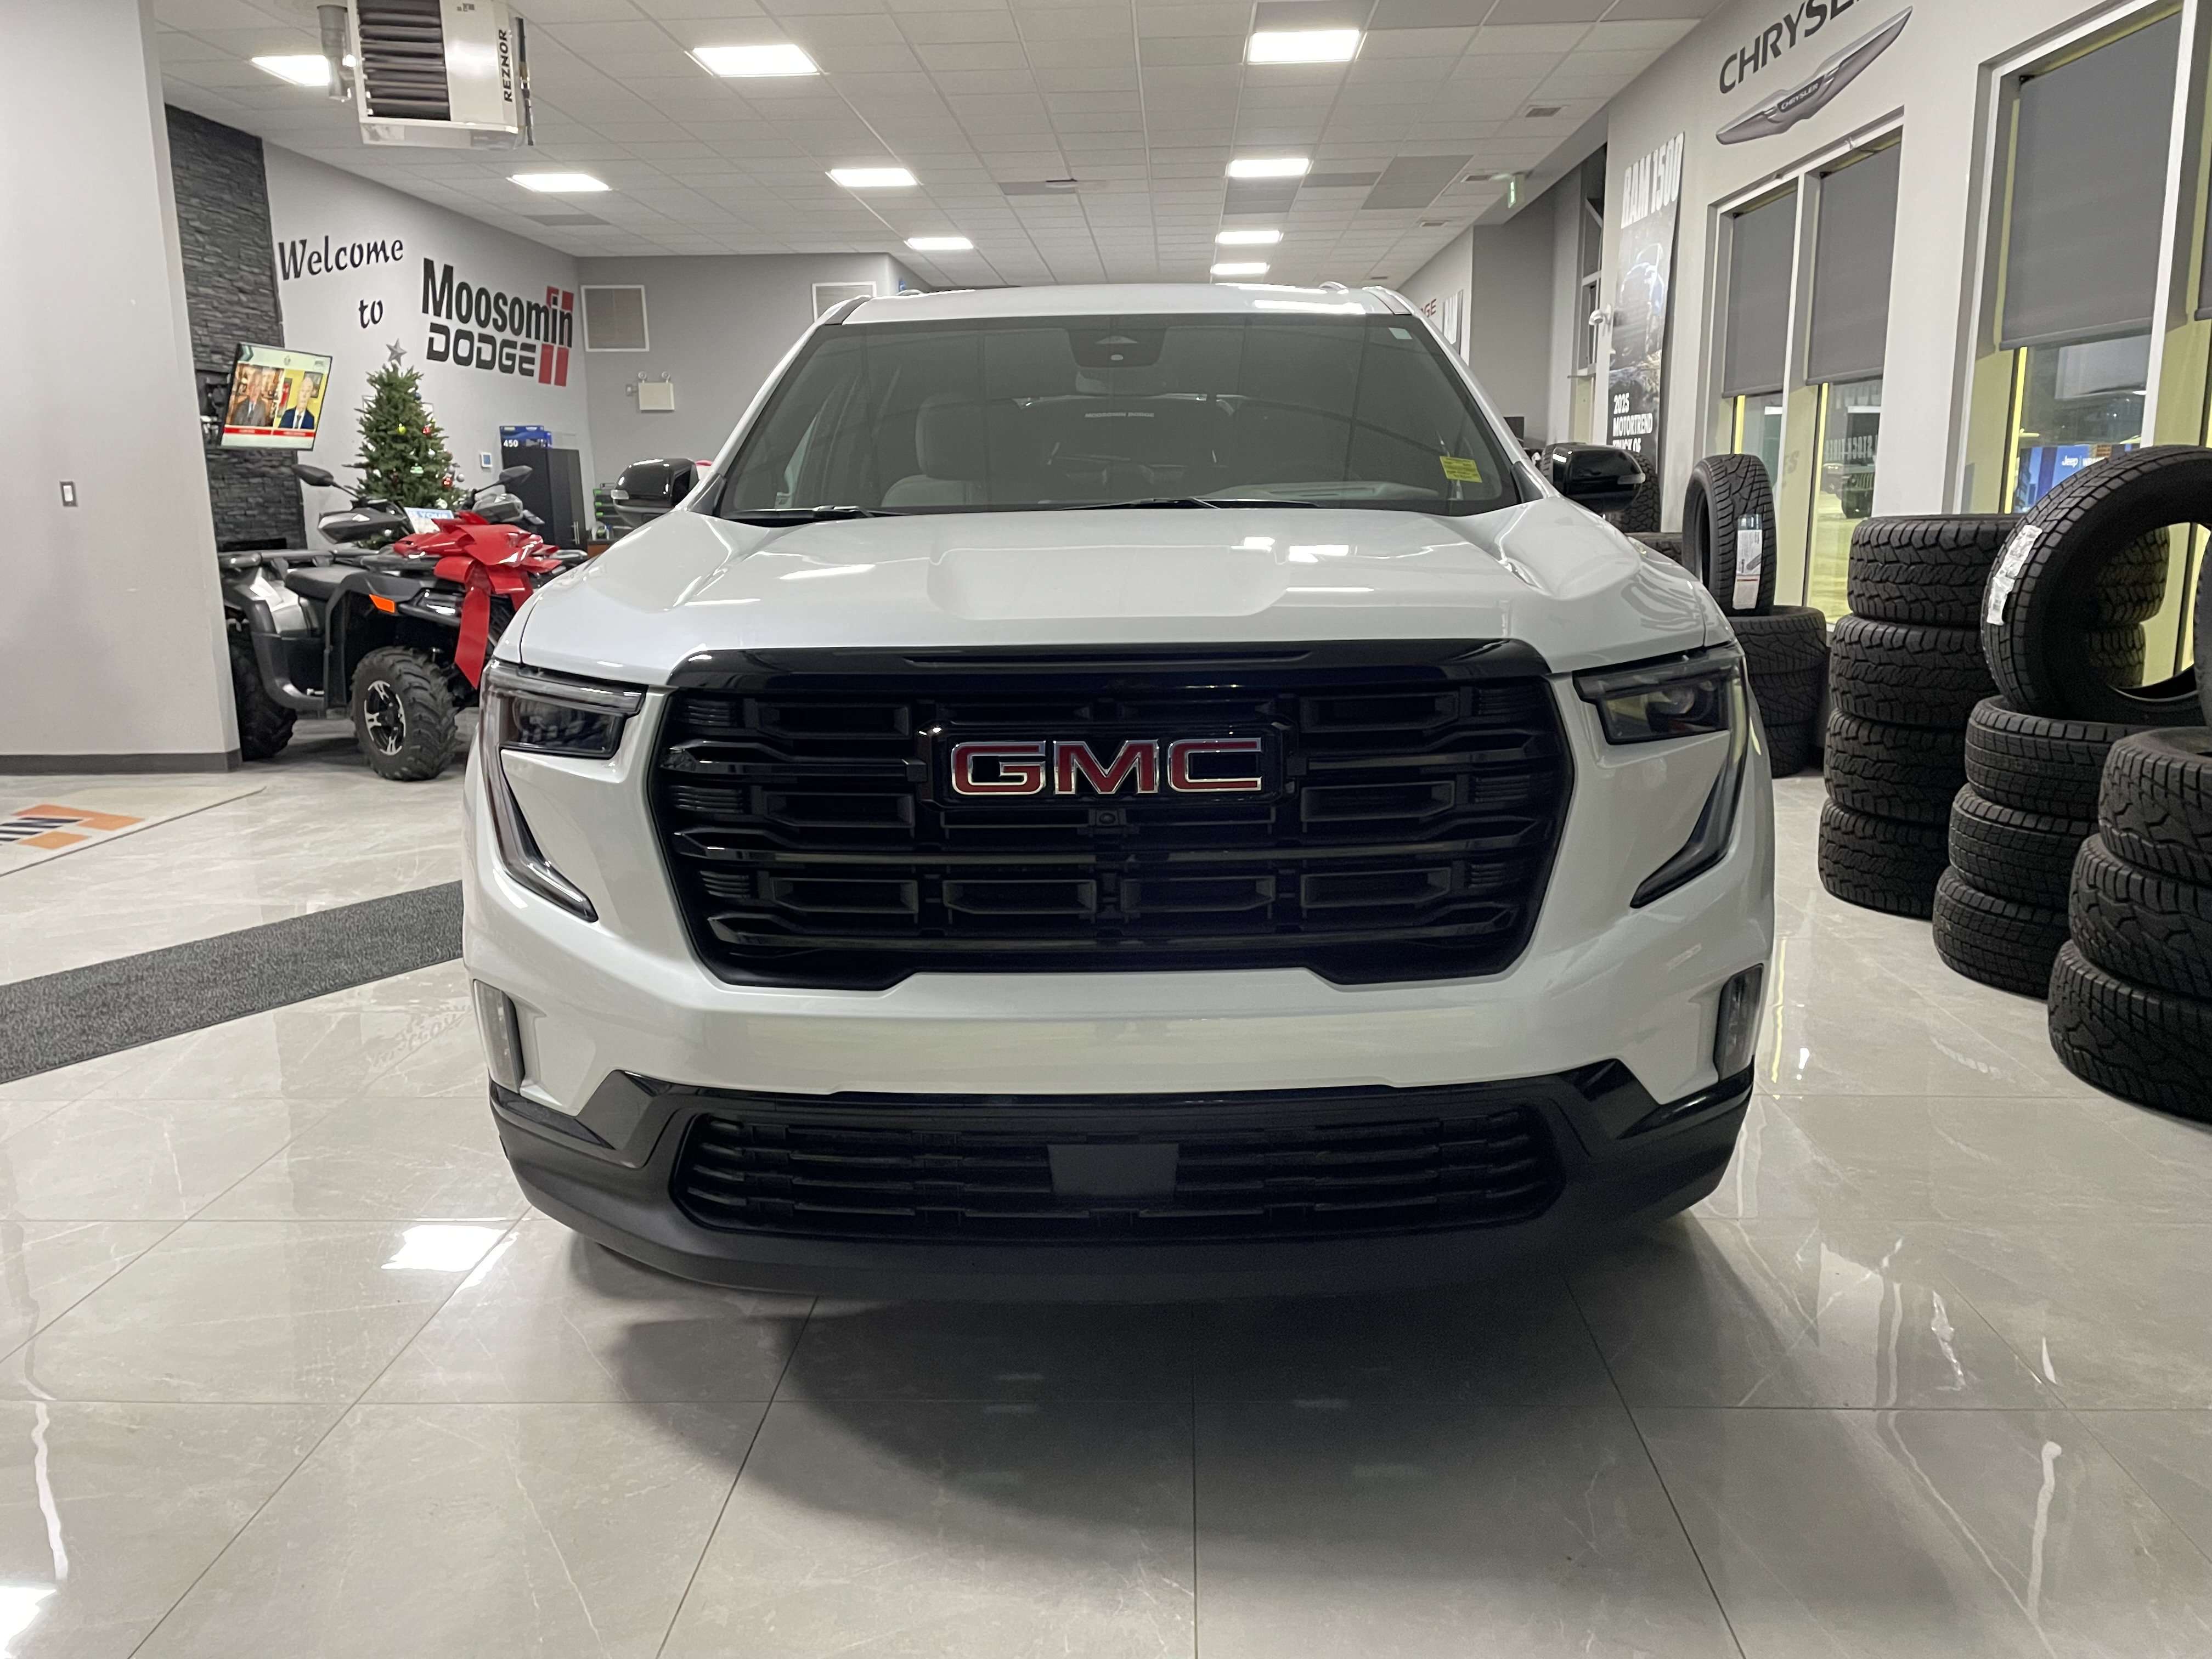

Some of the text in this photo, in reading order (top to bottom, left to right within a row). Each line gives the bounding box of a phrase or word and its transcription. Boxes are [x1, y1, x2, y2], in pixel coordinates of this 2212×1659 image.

[499, 29, 512, 103] REZNOR
[1719, 0, 1859, 94] CHRYSL
[1781, 83, 1818, 109] CHRYSLER
[1621, 132, 1684, 229] RAM 1500
[278, 235, 404, 280] Welcome
[358, 299, 383, 329] to
[422, 258, 573, 348] Moosomin
[426, 323, 536, 377] DODGE
[1612, 413, 1653, 437] MOTORTREND
[1613, 393, 1629, 414] 2025
[2062, 455, 2078, 468] Jeep
[951, 737, 1262, 795] GMC
